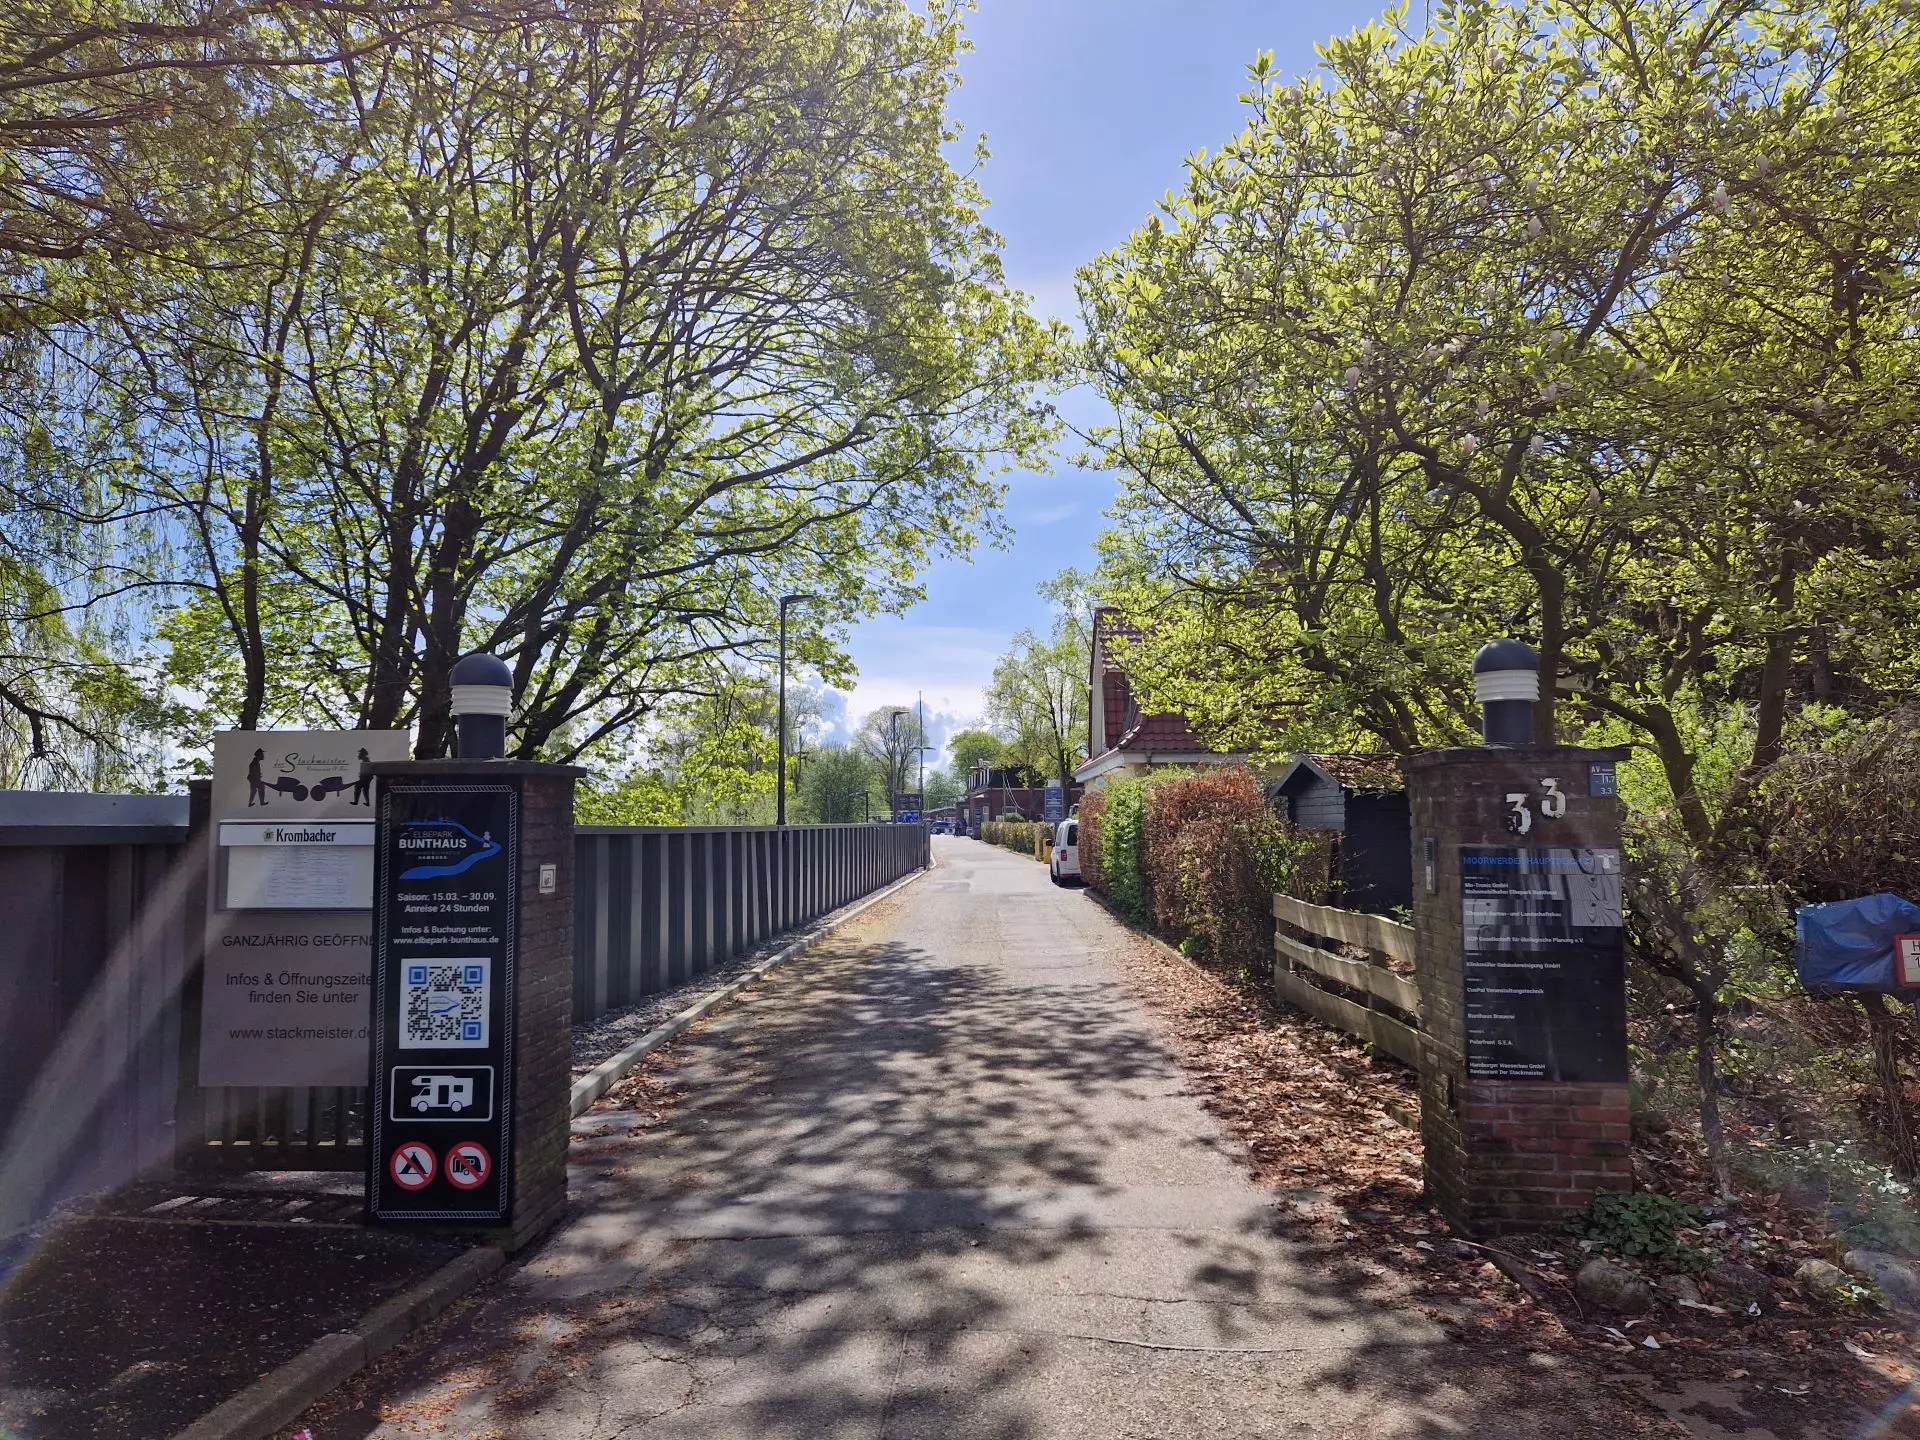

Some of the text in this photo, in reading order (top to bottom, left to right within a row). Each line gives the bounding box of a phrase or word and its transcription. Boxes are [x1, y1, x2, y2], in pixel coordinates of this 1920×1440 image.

[276, 827, 337, 842] Krombacher
[413, 831, 453, 839] ELBEPARK
[398, 838, 467, 849] BUNTHAUS
[397, 892, 430, 901] Saison:
[432, 892, 460, 901] 15.03.
[469, 892, 497, 901] 30.09.
[404, 903, 490, 912] Anreise 24 Stunden
[401, 925, 492, 935] Infos & Buchung unter:
[222, 933, 309, 947] GANZJÄHRIG
[393, 936, 500, 946] www.elbepark-bunthaus.de
[226, 973, 260, 986] Infos
[264, 973, 273, 986] &
[249, 990, 359, 1004] finden Sie unter
